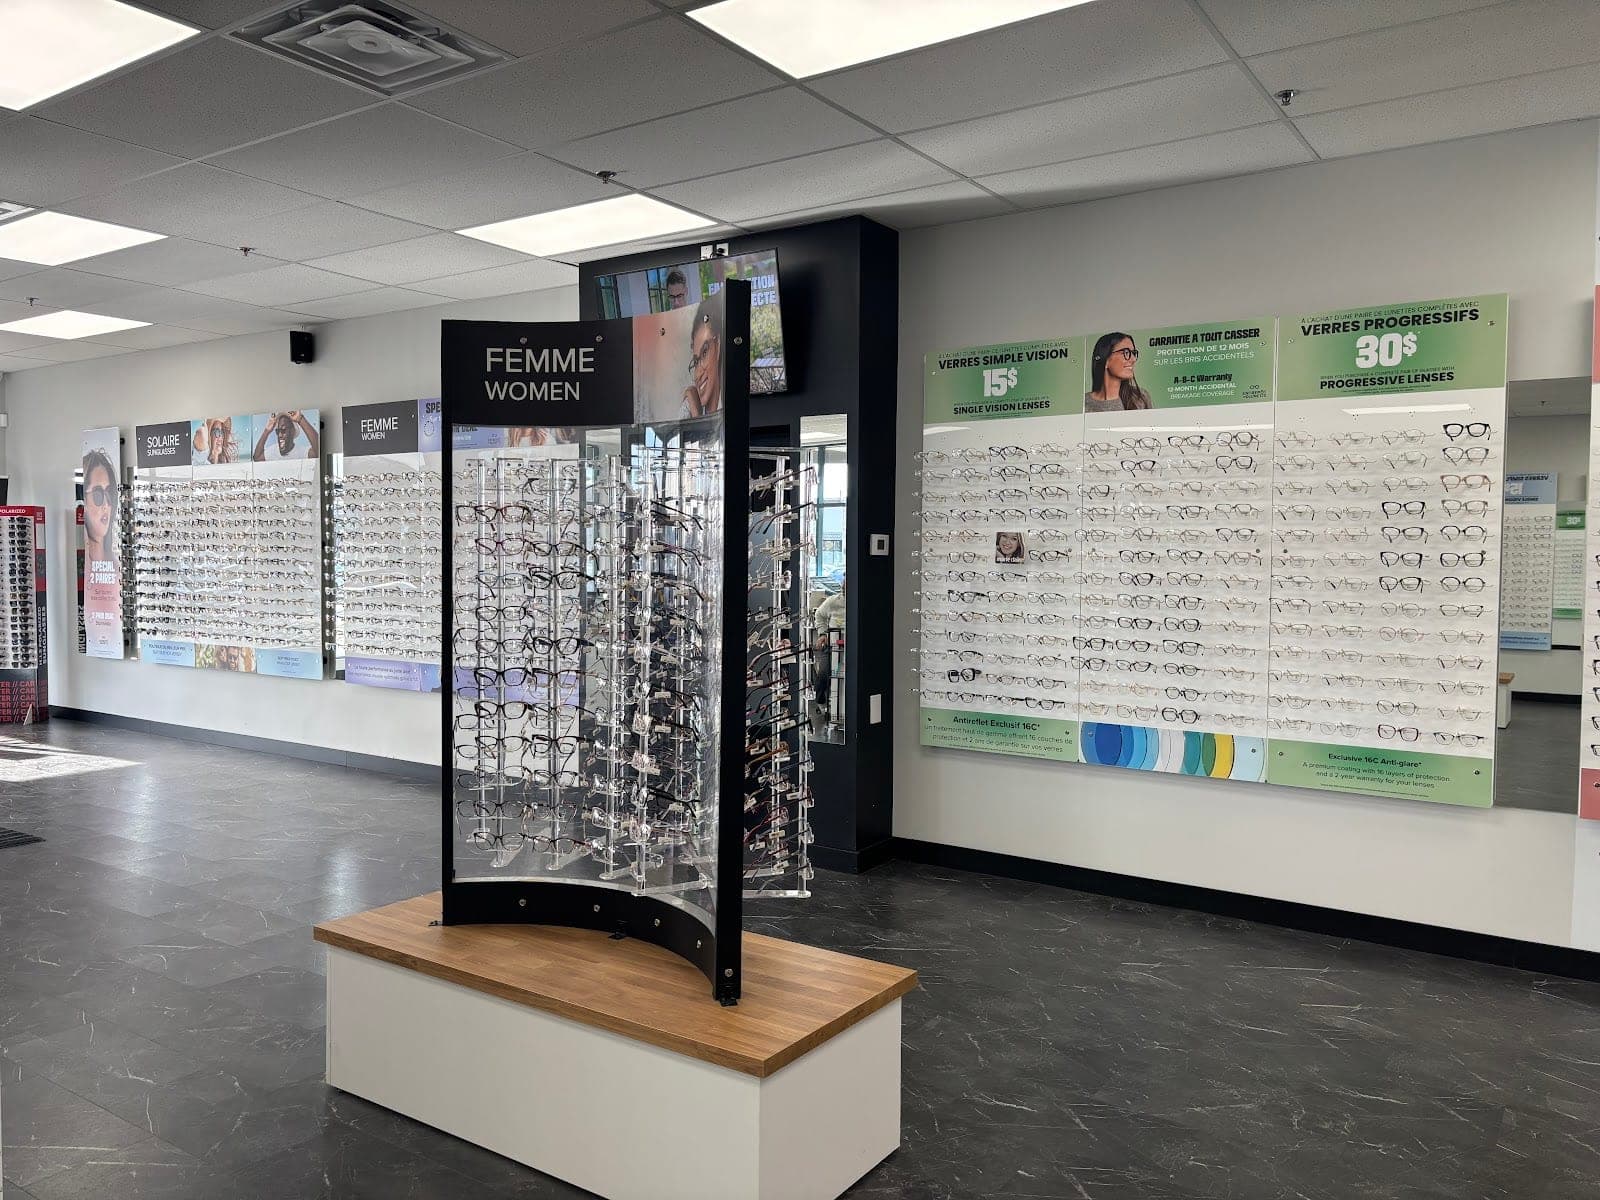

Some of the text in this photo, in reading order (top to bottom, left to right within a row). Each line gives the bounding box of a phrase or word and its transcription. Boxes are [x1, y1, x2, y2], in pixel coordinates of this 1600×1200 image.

[1301, 308, 1480, 336] VERRES PROGRESSIFS
[1149, 334, 1190, 346] GARANTIE
[1200, 332, 1222, 342] TOUT
[1224, 328, 1260, 340] CASSER
[939, 348, 1068, 369] VERRES SIMPLE VISION
[1157, 347, 1204, 356] PROTECTION
[1202, 352, 1254, 361] ACCIDENTELS
[487, 348, 594, 372] FEMME
[1320, 376, 1405, 389] PROGRESSIVE
[1408, 372, 1454, 383] LENSES
[485, 381, 580, 400] WOMEN
[954, 406, 983, 415] SINGLE
[985, 403, 1015, 412] VISION
[1018, 401, 1050, 410] LENSES
[361, 417, 398, 432] FEMME
[147, 434, 180, 448] SOLAIRE
[362, 432, 385, 440] WOMEN
[147, 448, 176, 456] SUNGLASSES
[953, 716, 988, 726] Antireflet
[990, 720, 1020, 728] Exclusif
[1328, 754, 1362, 762] Exclusive
[1416, 774, 1450, 782] protection
